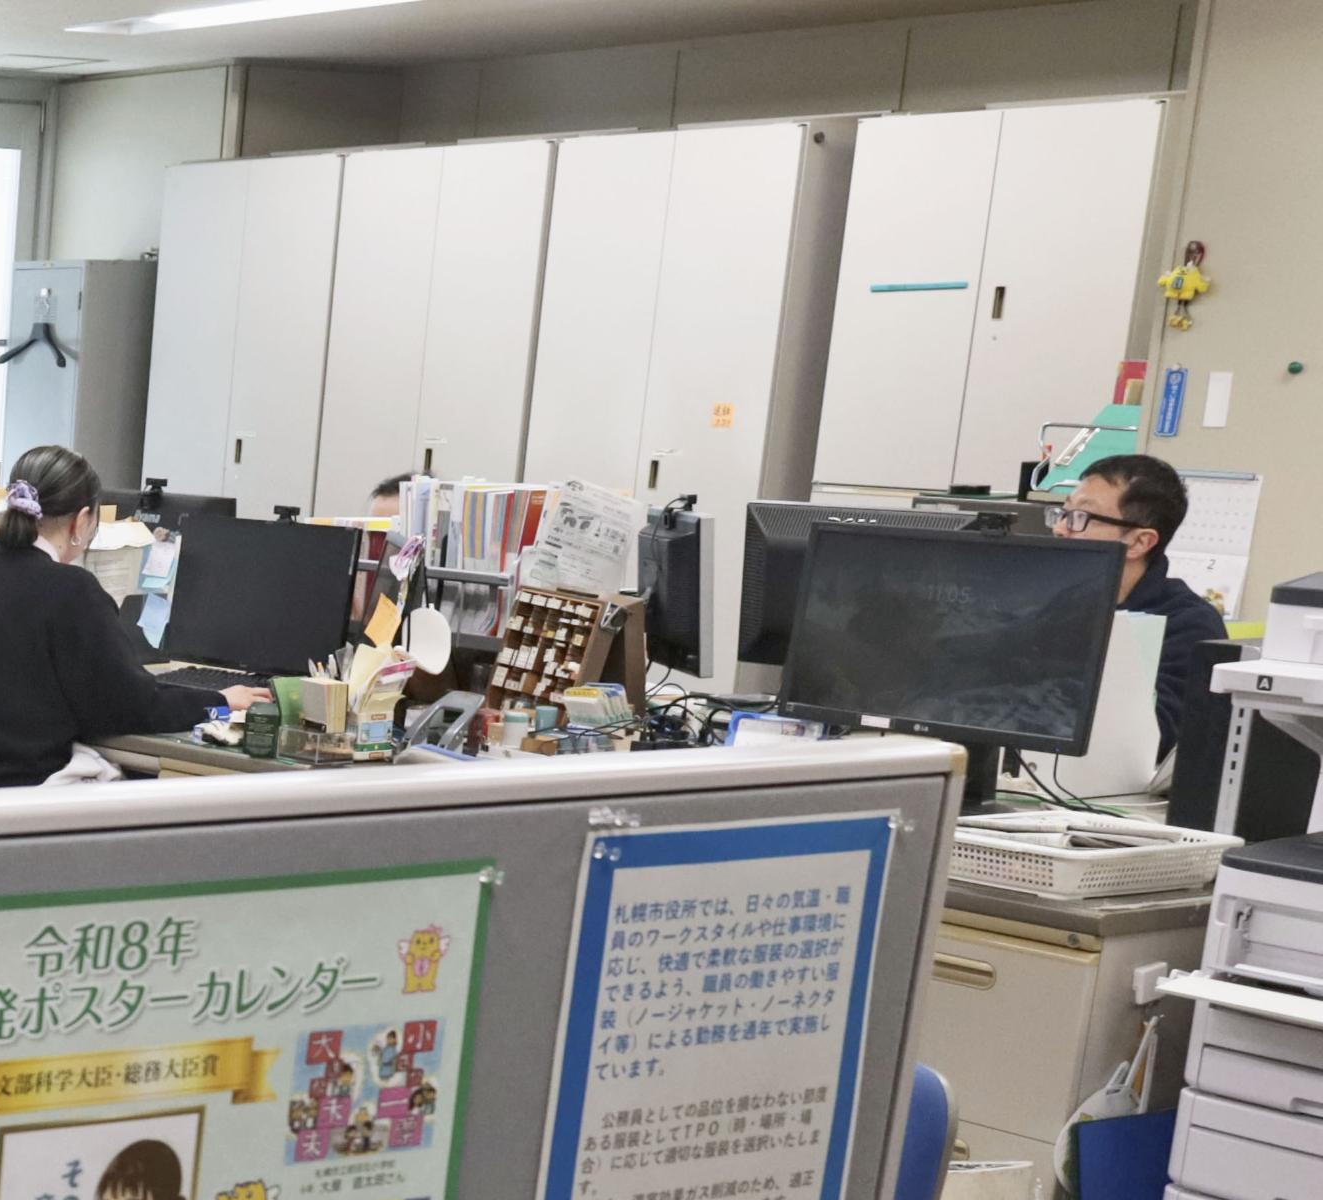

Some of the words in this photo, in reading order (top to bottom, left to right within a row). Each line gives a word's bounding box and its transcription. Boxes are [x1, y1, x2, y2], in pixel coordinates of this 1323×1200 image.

[1207, 559, 1216, 570] 2
[1258, 677, 1270, 690] A
[614, 885, 852, 924] 札幌市役所では、日々の気温・職
[24, 915, 200, 979] 令和8年
[610, 913, 847, 951] 員のワークスタイルや仕事環境に
[606, 937, 844, 977] 応じ、快適で柔軟な服装の選択が
[605, 962, 840, 1002] できるよう、職員の働きやすい服
[595, 1058, 665, 1081] ています。
[579, 1180, 598, 1196] す。
